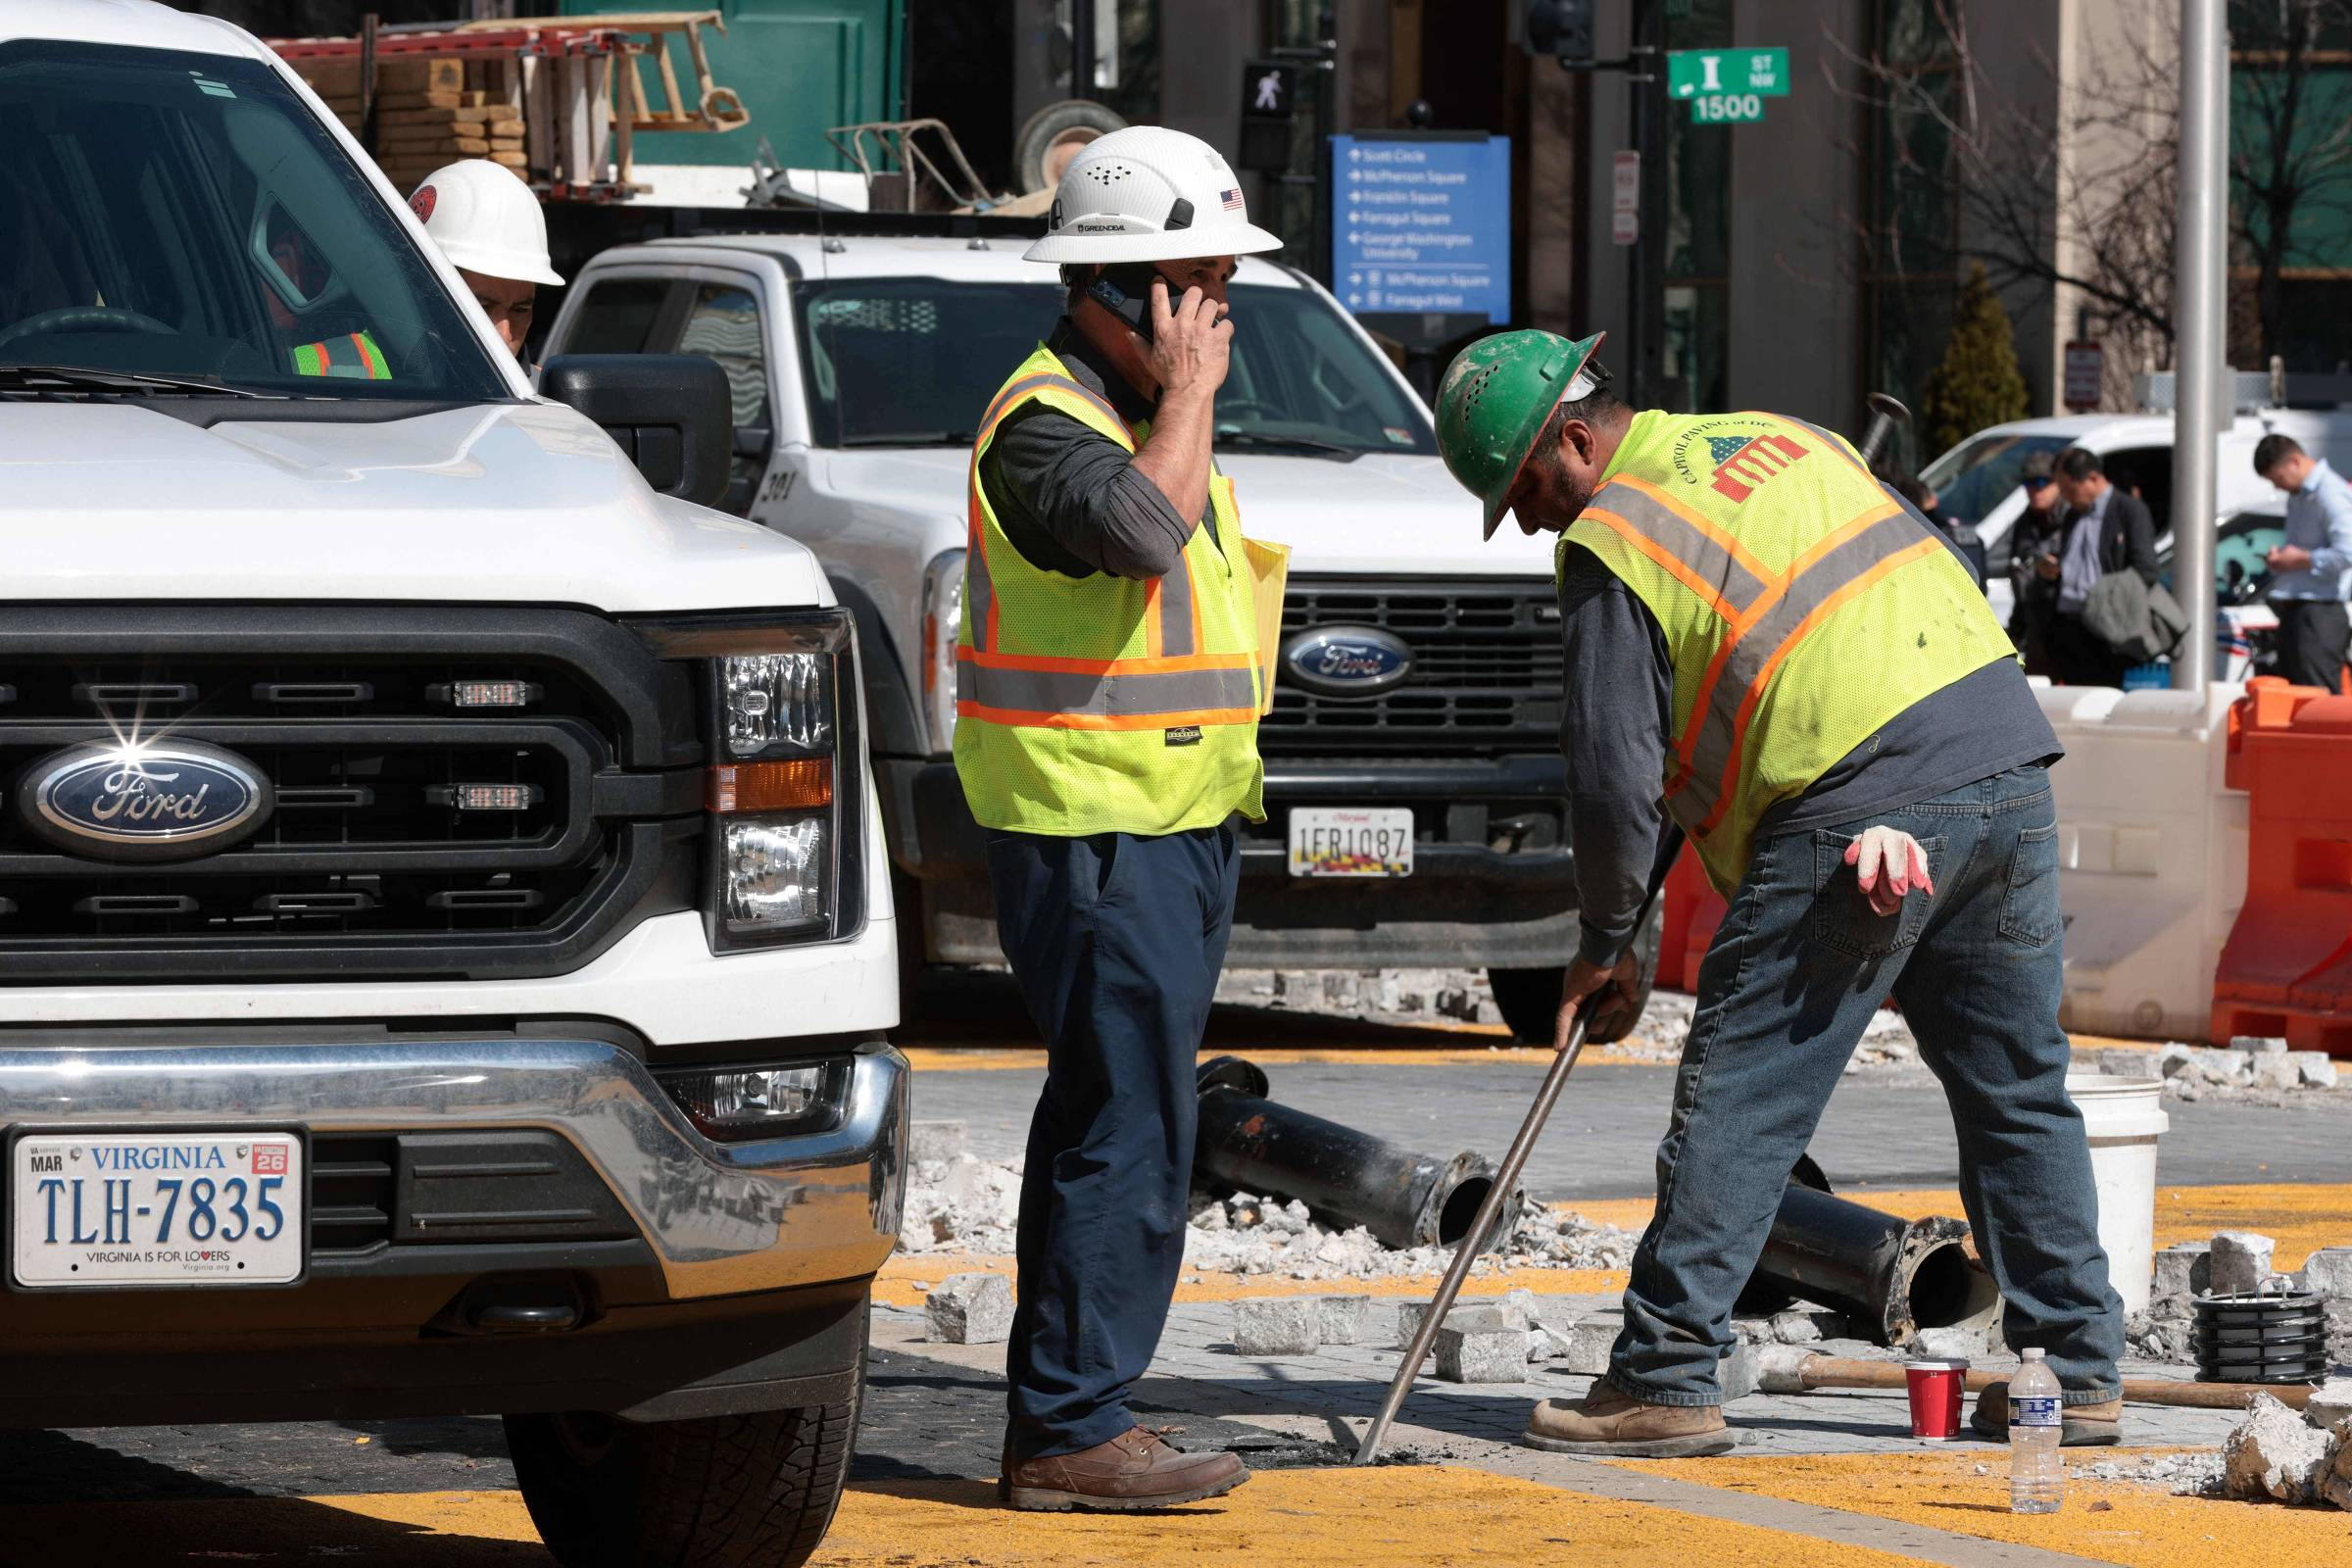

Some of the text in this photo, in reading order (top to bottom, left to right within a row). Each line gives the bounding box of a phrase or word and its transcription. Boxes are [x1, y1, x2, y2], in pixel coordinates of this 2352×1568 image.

[1751, 55, 1773, 72] ST
[1700, 56, 1722, 90] I
[1749, 74, 1777, 88] NW
[1694, 93, 1761, 120] 1500
[1362, 149, 1426, 163] Scott Circle
[1363, 170, 1467, 184] McPherson Square
[1363, 191, 1449, 206] Franklin Square
[1363, 212, 1451, 227] Farragut Square
[1363, 232, 1473, 248] George Washington
[1363, 247, 1419, 262] University
[1387, 272, 1491, 288] McPherson Square
[1387, 293, 1463, 309] Farragut West
[1682, 420, 1729, 442] PAVING
[1674, 441, 1697, 485] CAPITOL
[1318, 645, 1382, 675] Ford
[92, 769, 210, 821] Ford
[30, 1155, 63, 1172] MAR
[91, 1146, 225, 1170] VIRGINIA
[257, 1155, 284, 1170] 26
[37, 1176, 285, 1245] TLH-7835
[86, 1251, 141, 1262] VIRGINIA
[145, 1251, 154, 1262] IS
[158, 1251, 181, 1262] FOR
[182, 1263, 230, 1272] Virginia.org
